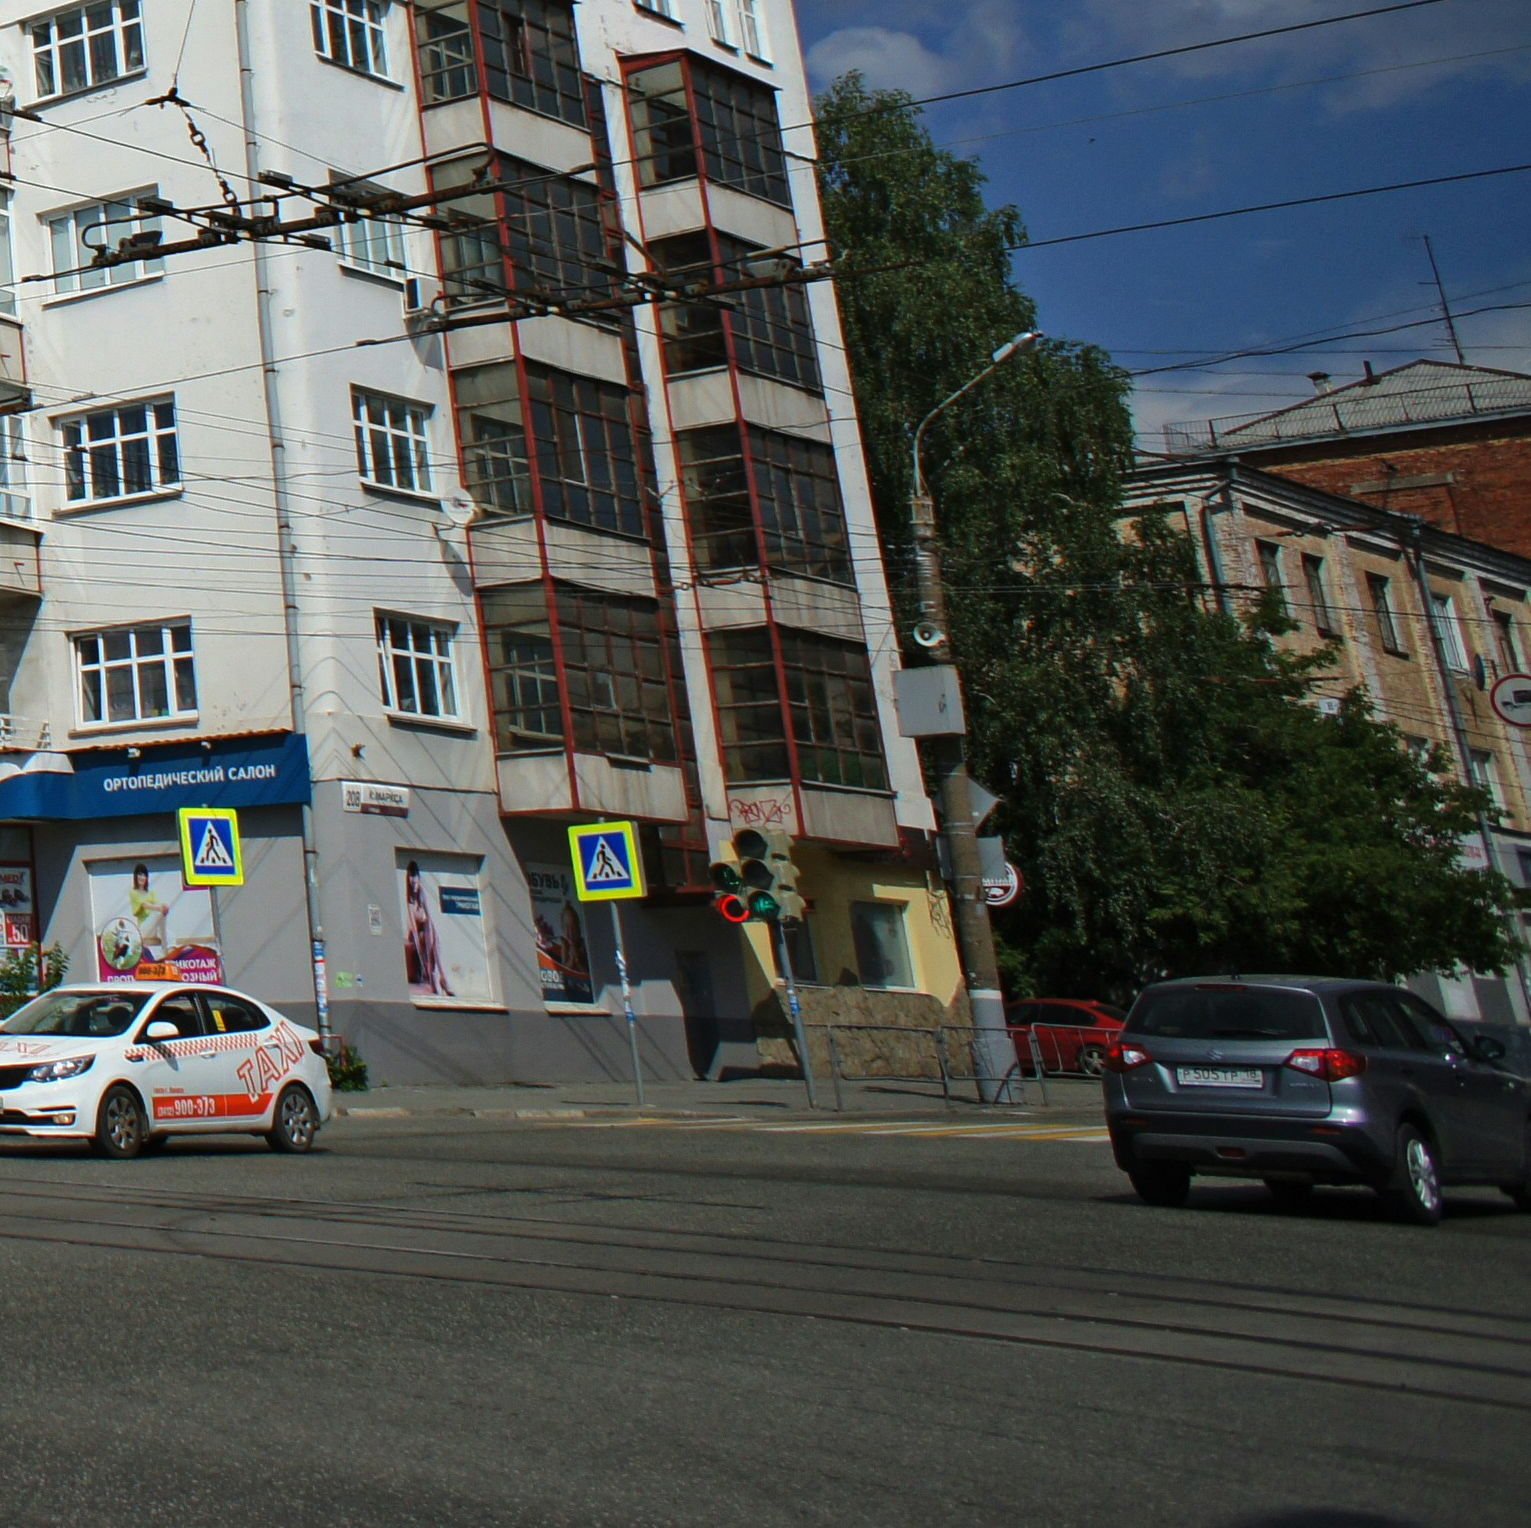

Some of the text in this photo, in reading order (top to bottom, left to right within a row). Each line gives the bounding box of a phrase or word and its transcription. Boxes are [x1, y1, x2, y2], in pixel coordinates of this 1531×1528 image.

[103, 764, 276, 791] ОРТОПЕДИЧЕСКИЙ САЛОН
[237, 1020, 305, 1104] TAXI
[174, 1095, 216, 1117] 900-373
